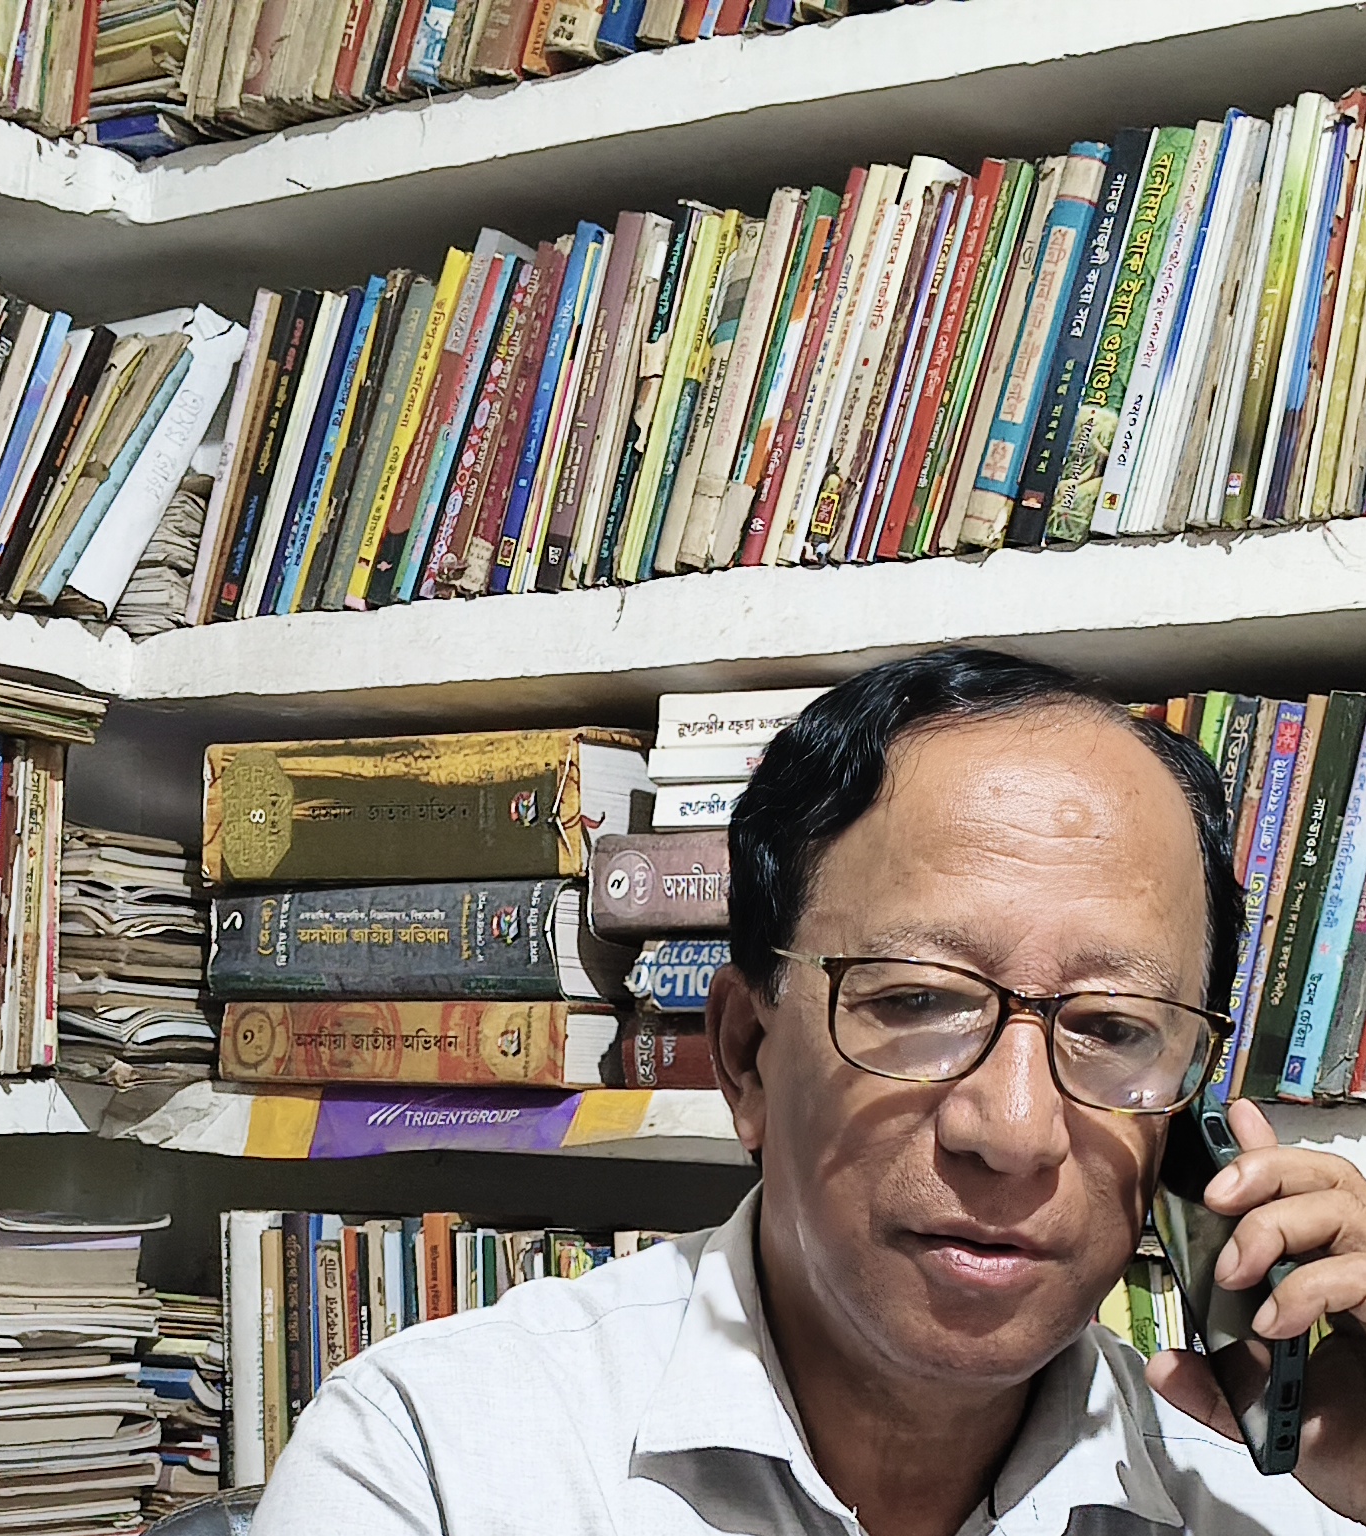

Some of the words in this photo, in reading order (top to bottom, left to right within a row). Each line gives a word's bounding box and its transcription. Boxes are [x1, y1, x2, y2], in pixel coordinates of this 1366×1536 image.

[538, 2, 551, 17] OF
[529, 19, 547, 56] ASSAM
[1121, 228, 1156, 273] আৰু
[297, 925, 347, 944] অসমীয়া
[295, 1027, 346, 1049] অসমীয়া
